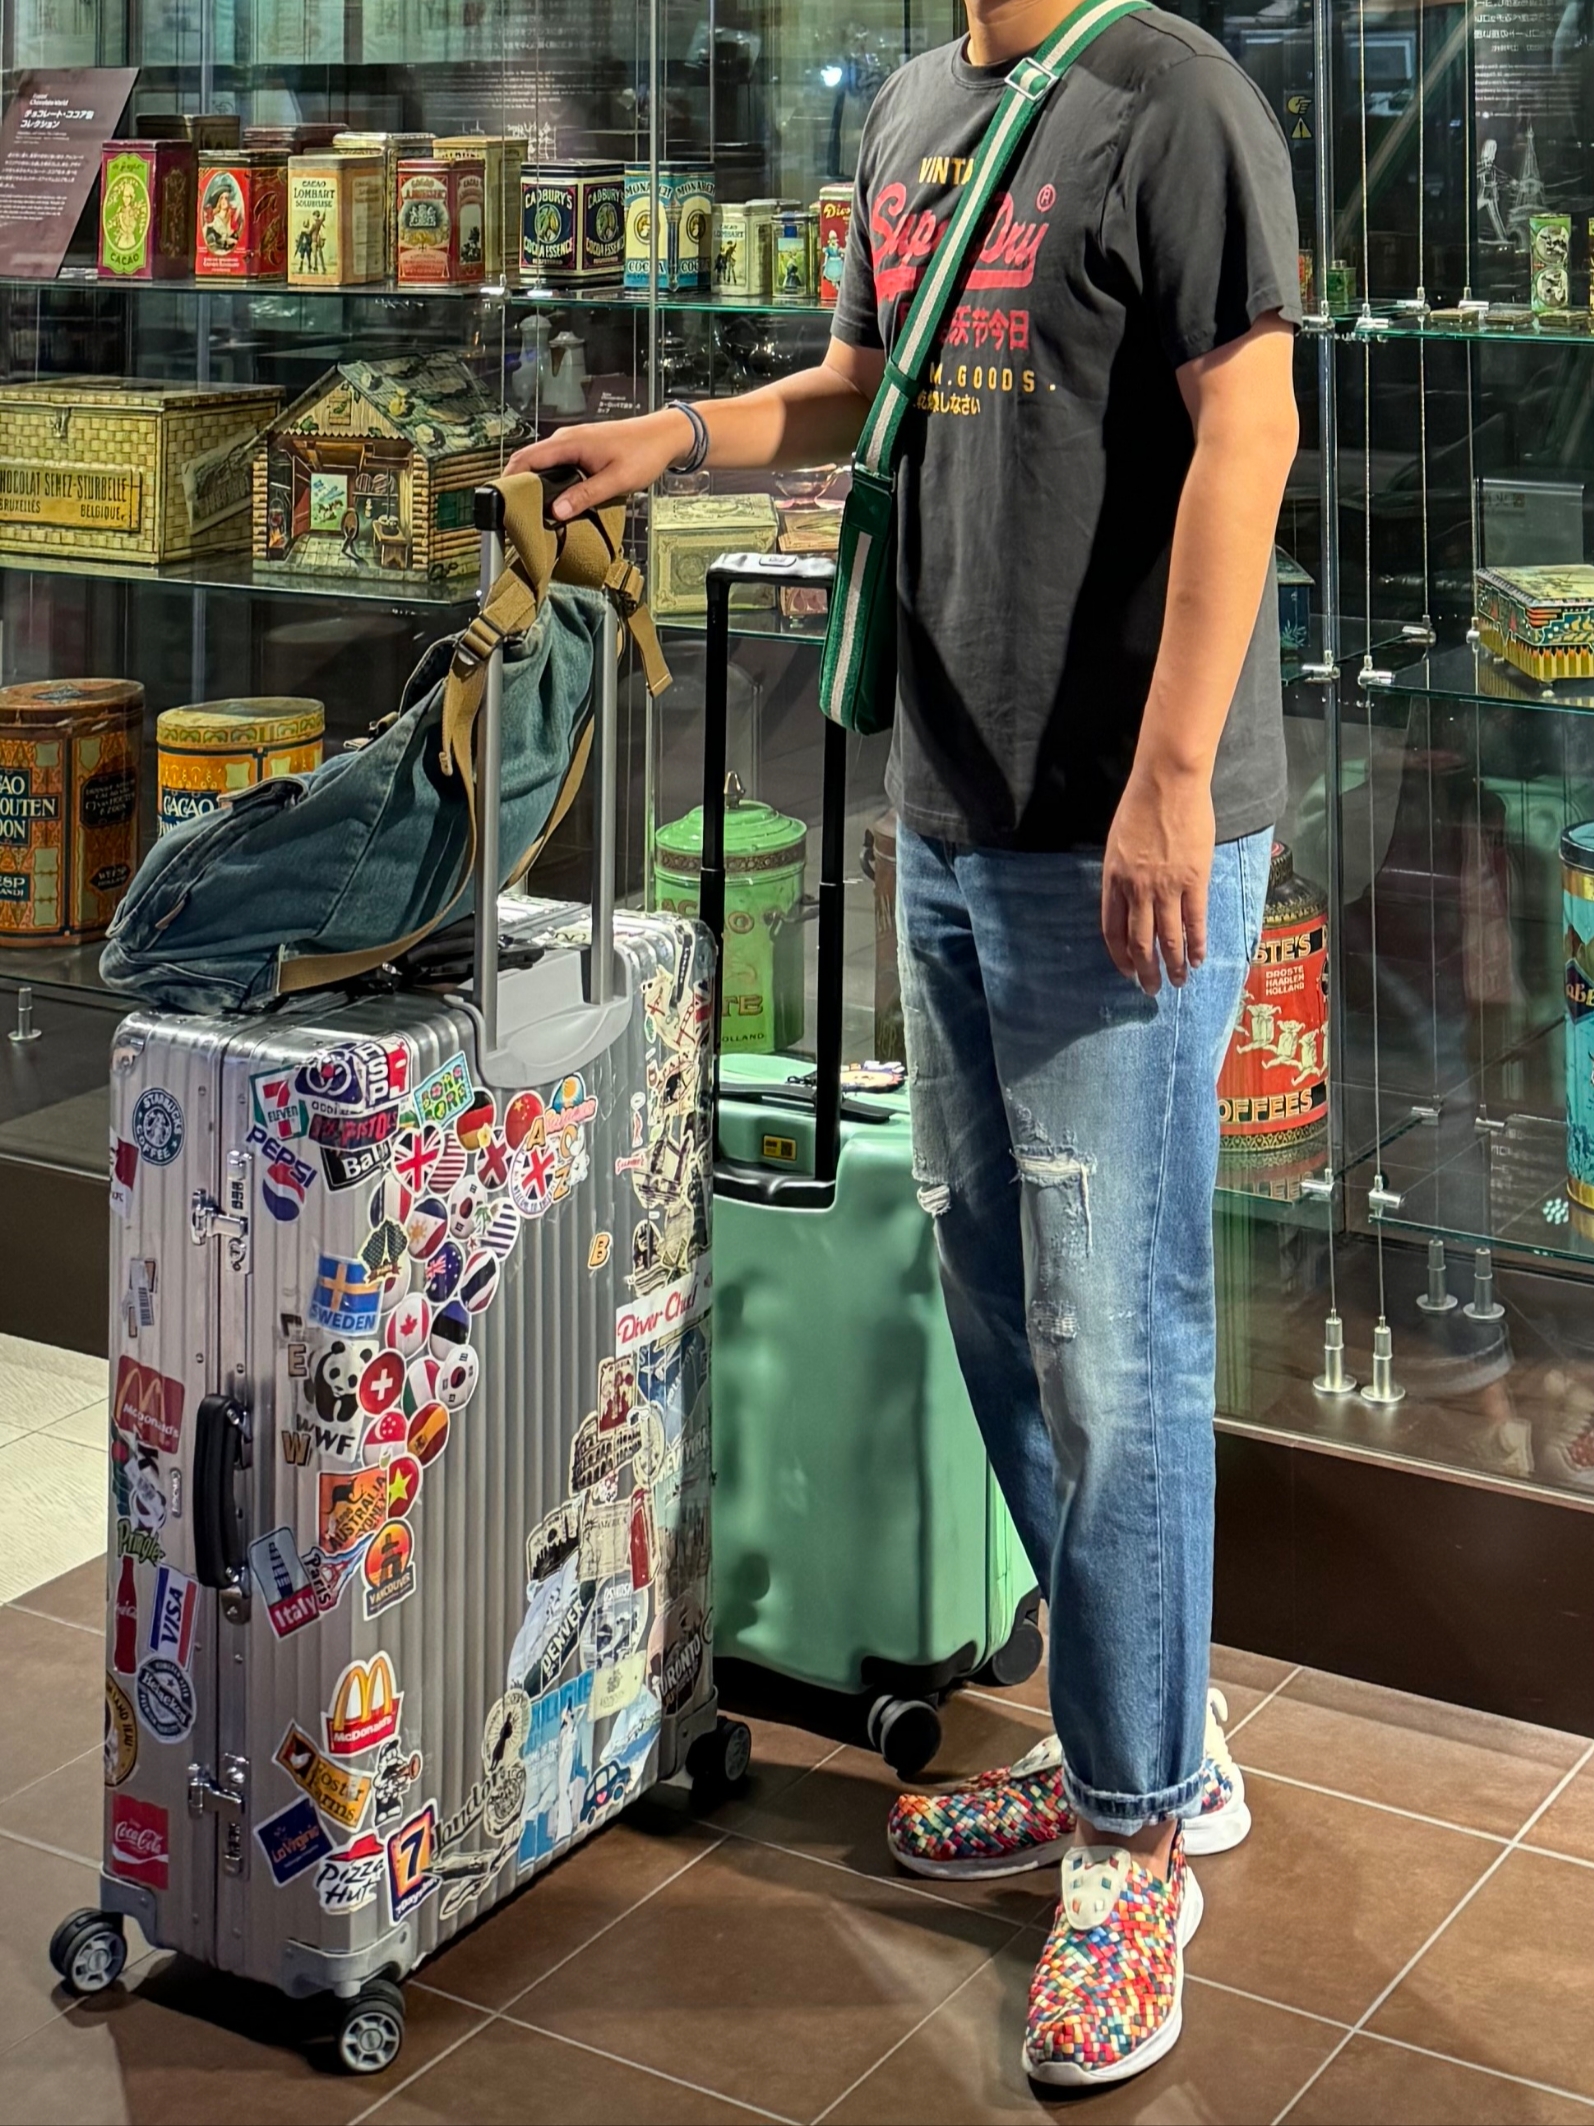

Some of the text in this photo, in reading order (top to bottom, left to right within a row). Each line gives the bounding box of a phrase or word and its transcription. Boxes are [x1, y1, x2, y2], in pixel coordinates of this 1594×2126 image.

[918, 157, 975, 186] VINTA
[293, 188, 335, 200] LOMBART
[525, 188, 573, 209] CADBURY'S
[625, 181, 673, 199] MONCH
[110, 253, 140, 266] CACAO
[545, 237, 573, 259] ESSENCE
[628, 259, 667, 275] COCA
[163, 796, 215, 819] CACAO
[1265, 966, 1304, 979] DROSTE
[1265, 983, 1305, 996] HOLLAND
[142, 1094, 183, 1135] STARBUCKS
[136, 1124, 171, 1161] COFFEE
[246, 1124, 318, 1189] PEPSI
[310, 1302, 376, 1332] SWEDEN
[296, 1413, 356, 1456] WWF
[328, 1475, 387, 1551] AUSTRALIA
[303, 1551, 332, 1605] Paris
[368, 1571, 411, 1606] VANCOUVER
[161, 1586, 184, 1646] VISA
[275, 1594, 319, 1628] Italy
[541, 1598, 585, 1676] DENVER
[652, 1632, 701, 1701] TORONTO
[142, 1671, 190, 1725] Heineken
[332, 1714, 393, 1743] McDonald's
[400, 1825, 427, 1887] 7
[316, 1857, 385, 1887] Pizza
[325, 1881, 376, 1905] Hut
